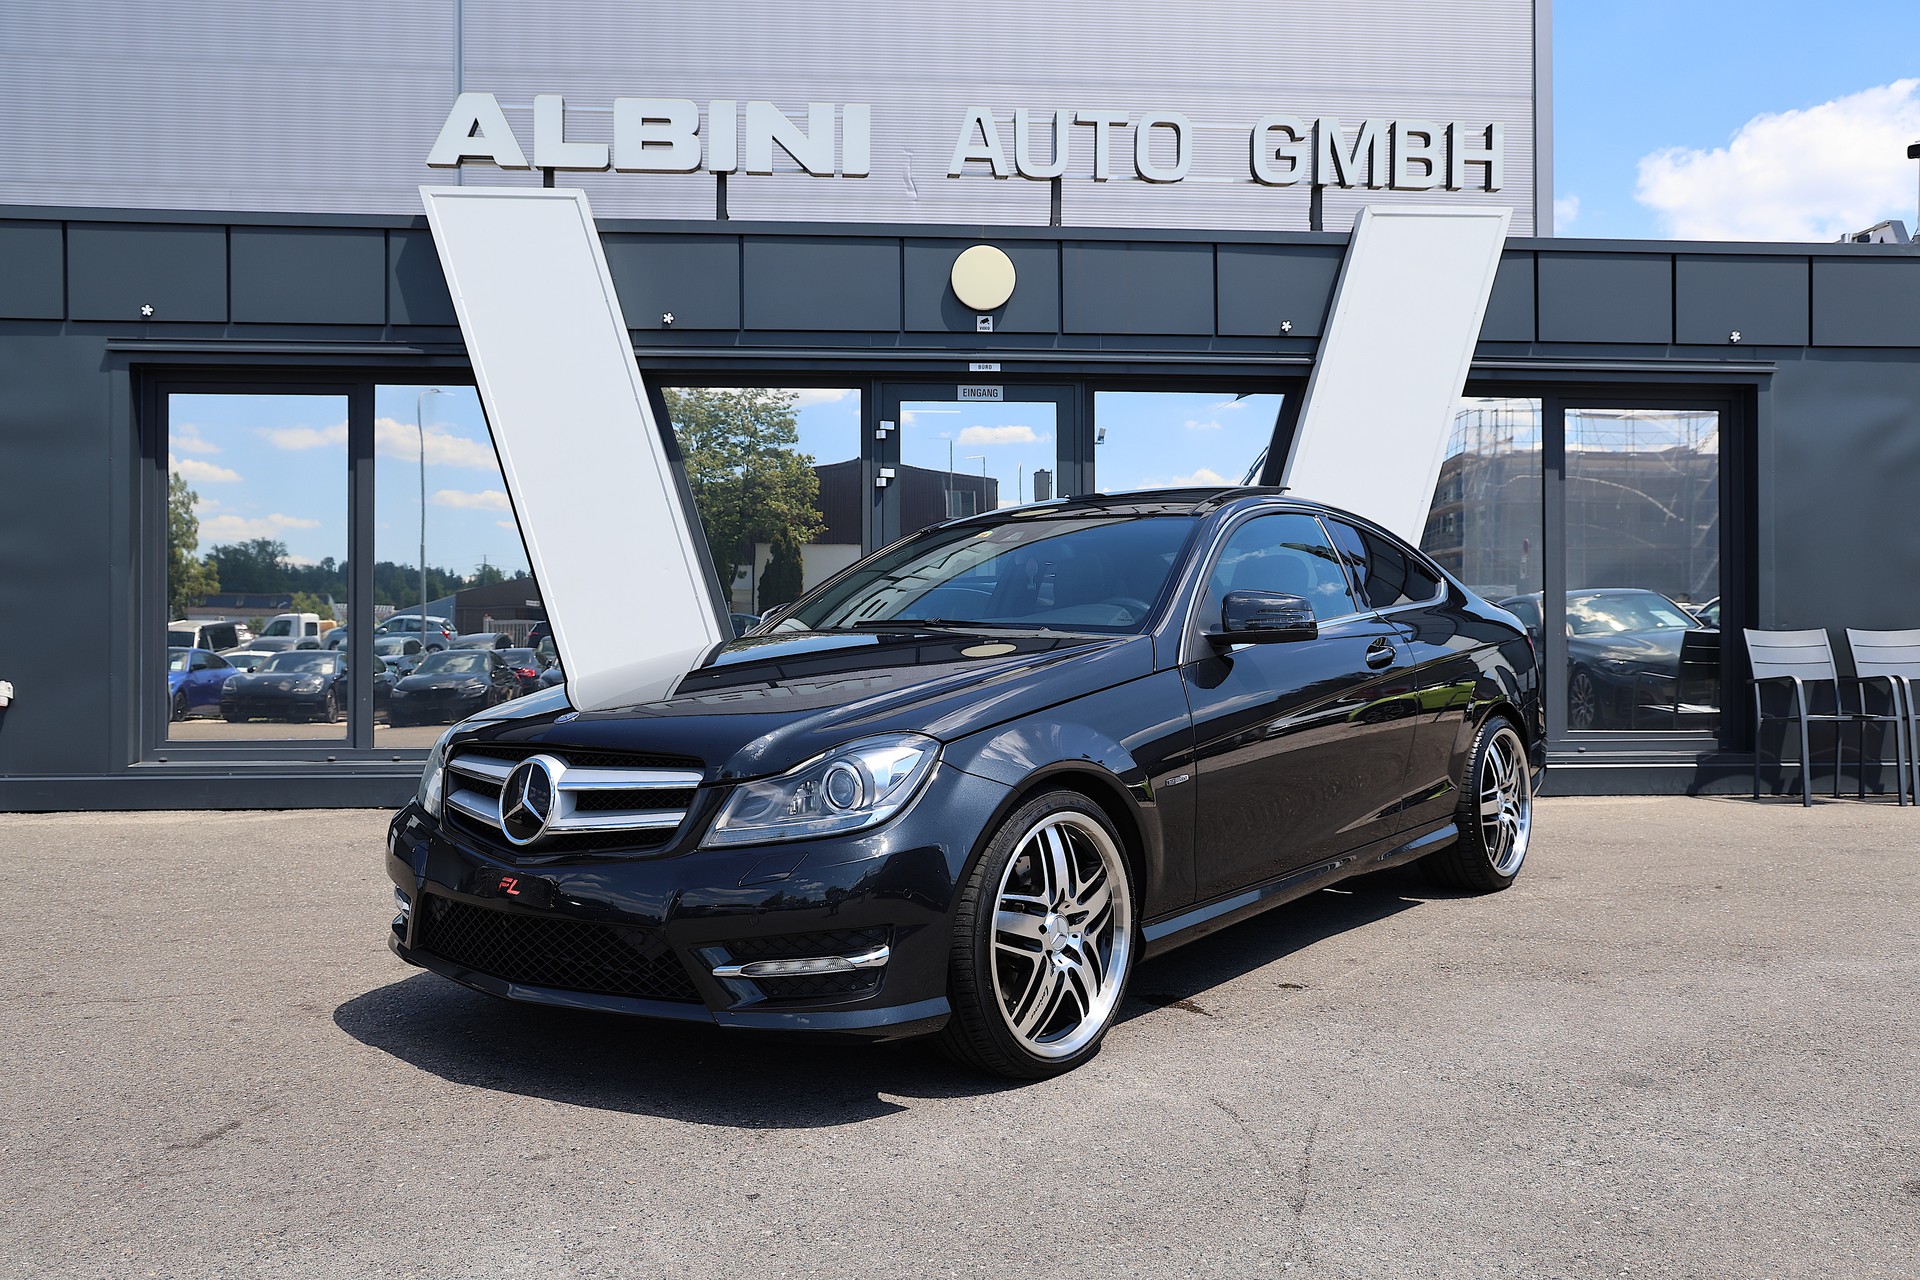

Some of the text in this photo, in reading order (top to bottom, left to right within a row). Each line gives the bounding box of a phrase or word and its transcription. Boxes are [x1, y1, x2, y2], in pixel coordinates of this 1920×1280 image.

[426, 92, 1505, 193] ALBINI AUTO GMBH
[962, 388, 999, 398] EINGANG
